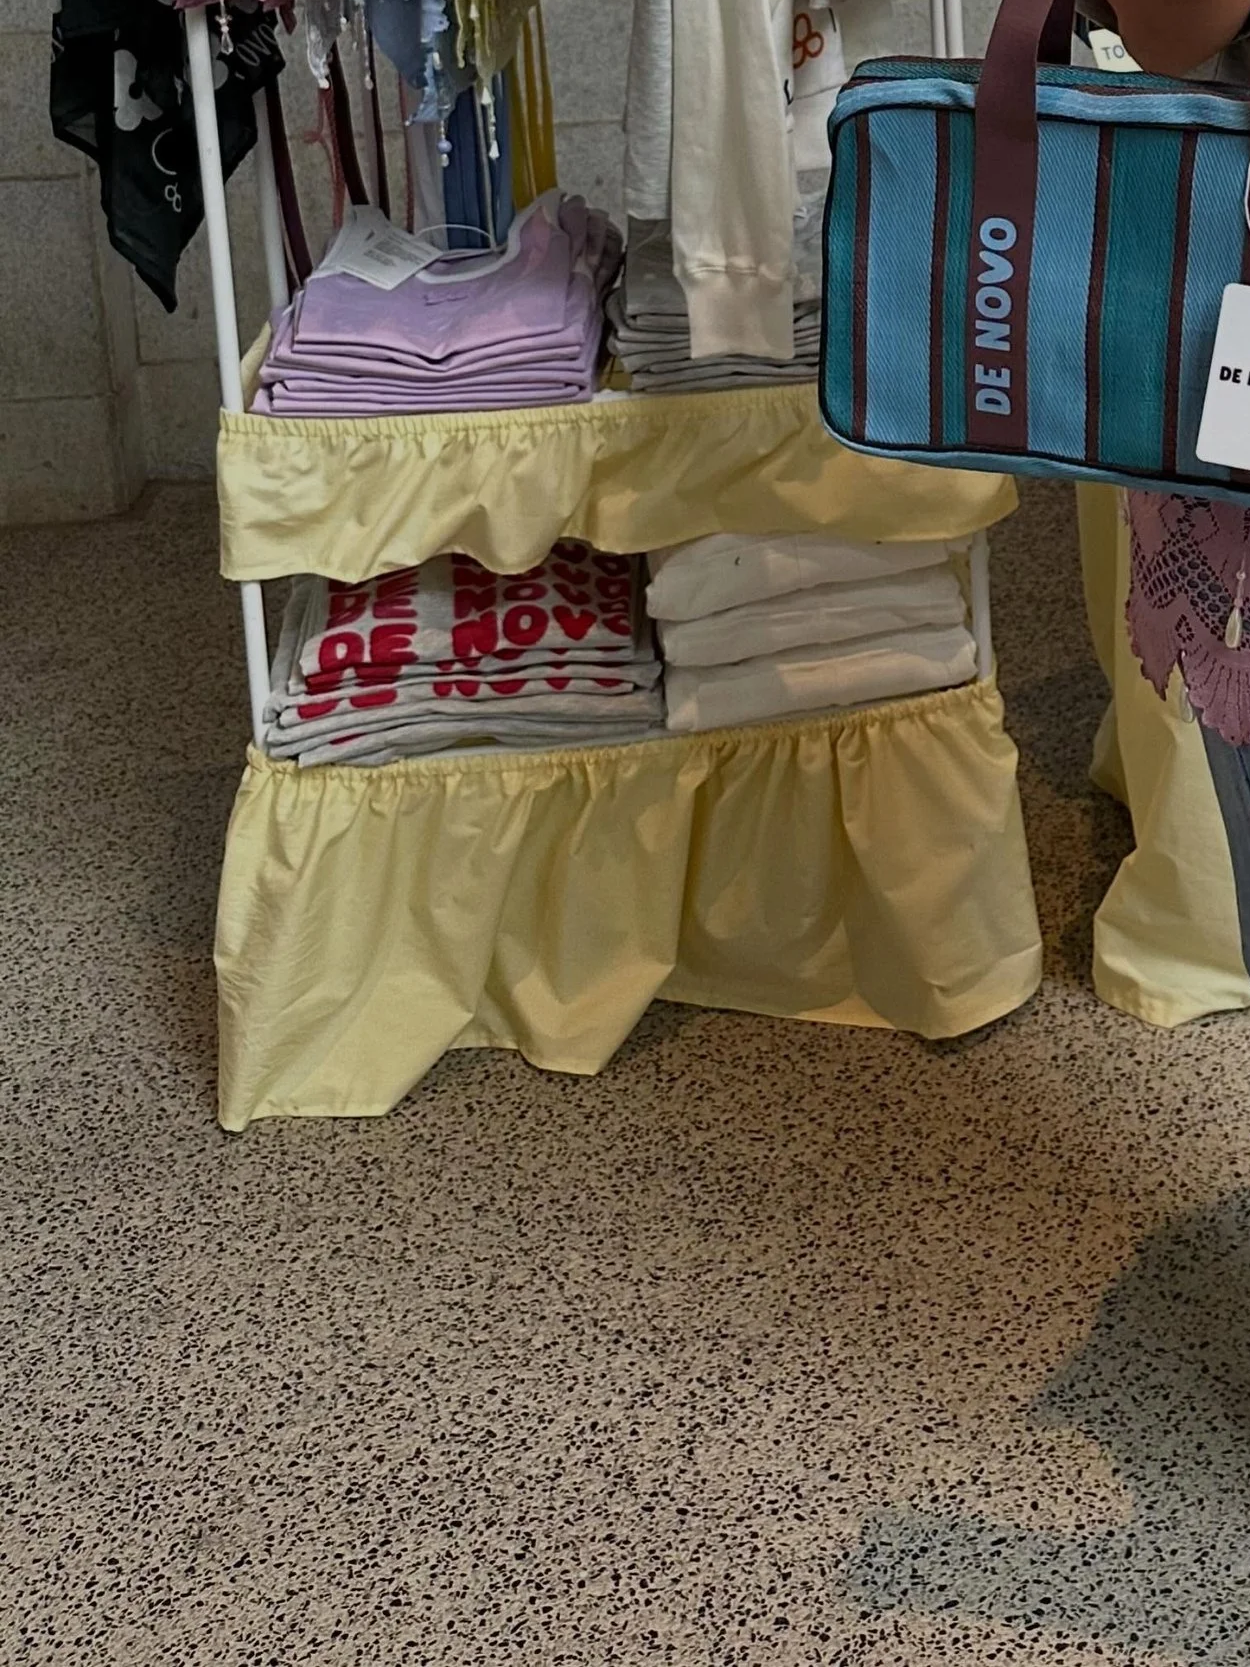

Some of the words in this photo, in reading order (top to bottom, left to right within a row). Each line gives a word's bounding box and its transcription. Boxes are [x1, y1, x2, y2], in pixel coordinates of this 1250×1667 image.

[974, 217, 1017, 352] NOVO
[974, 363, 1012, 416] DE
[1219, 366, 1243, 384] DE
